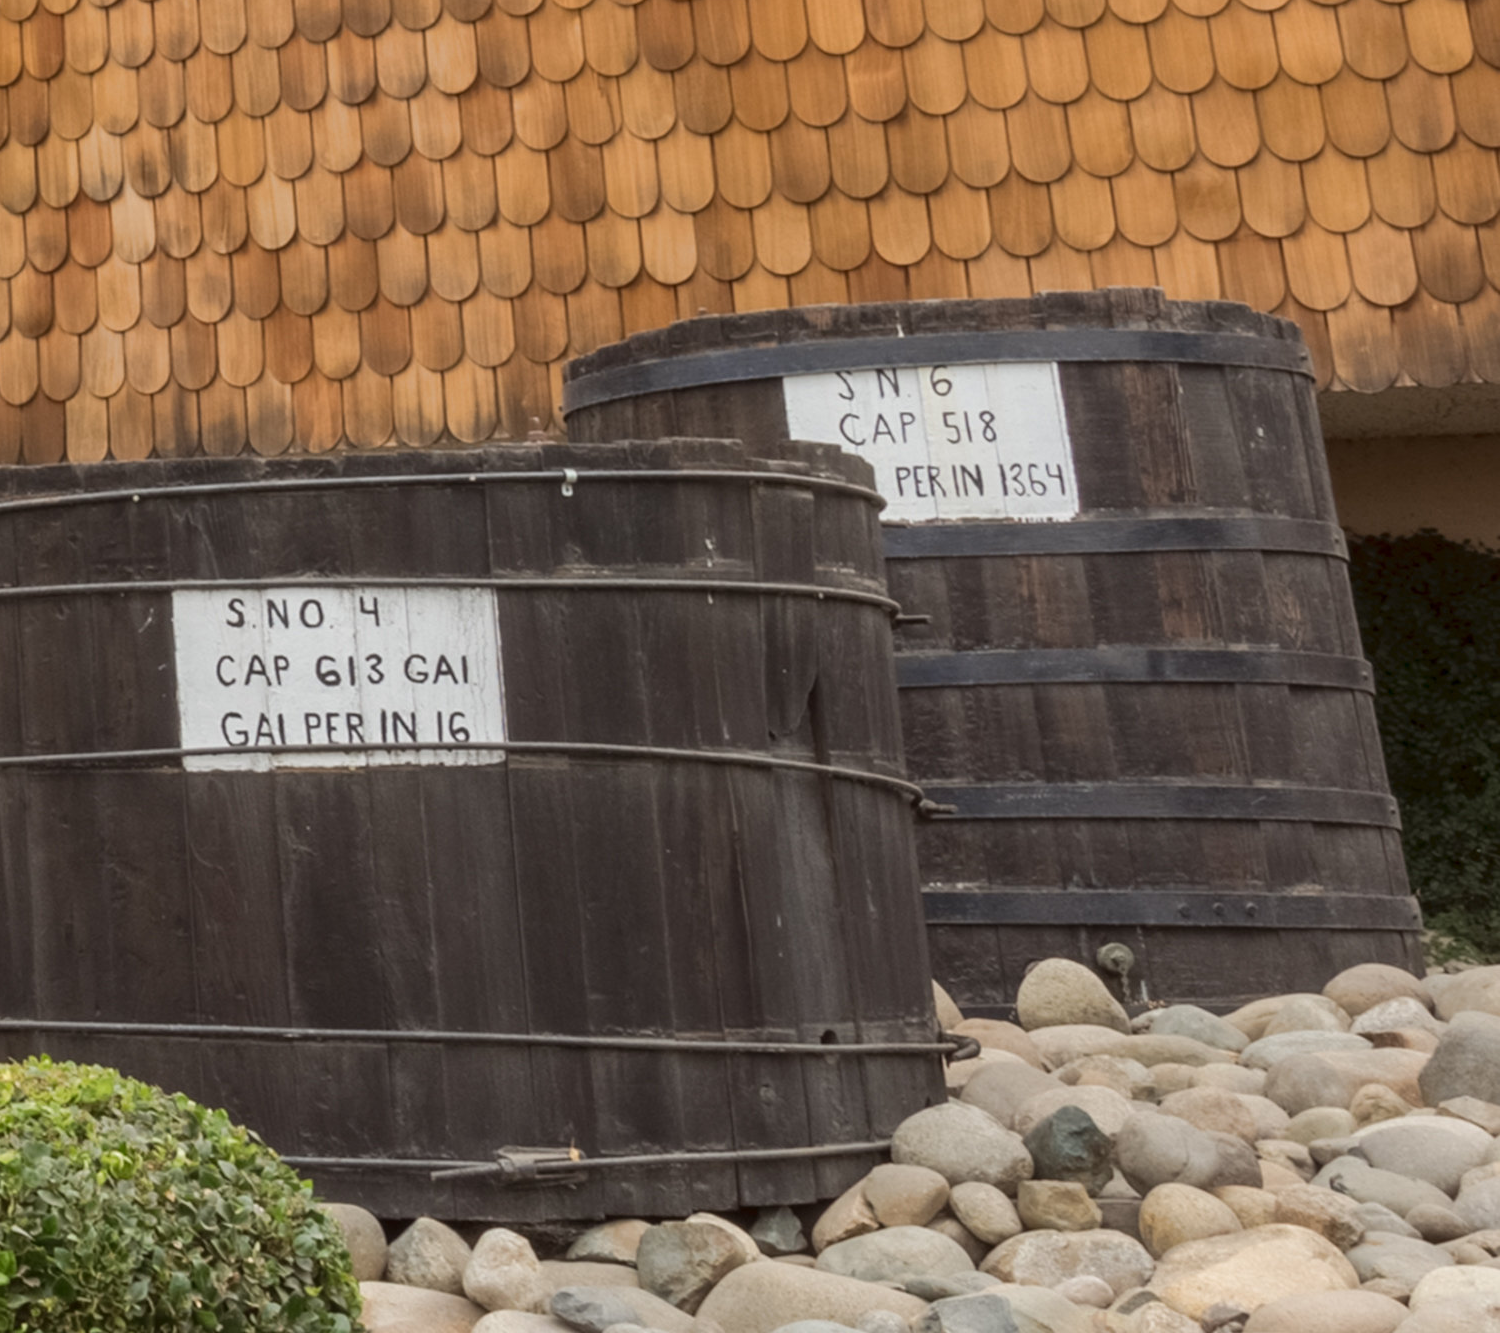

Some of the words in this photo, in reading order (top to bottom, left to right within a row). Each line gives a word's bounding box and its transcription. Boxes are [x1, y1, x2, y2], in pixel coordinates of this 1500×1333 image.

[929, 365, 953, 397] 6
[838, 411, 916, 446] CAP
[942, 410, 998, 445] 518
[896, 465, 947, 498] PER
[952, 464, 984, 498] IN
[359, 595, 381, 627] 4
[215, 655, 290, 687] CAP
[314, 654, 385, 687] 613
[304, 710, 365, 745] PER
[380, 708, 417, 744] IN
[437, 709, 472, 744] 16
